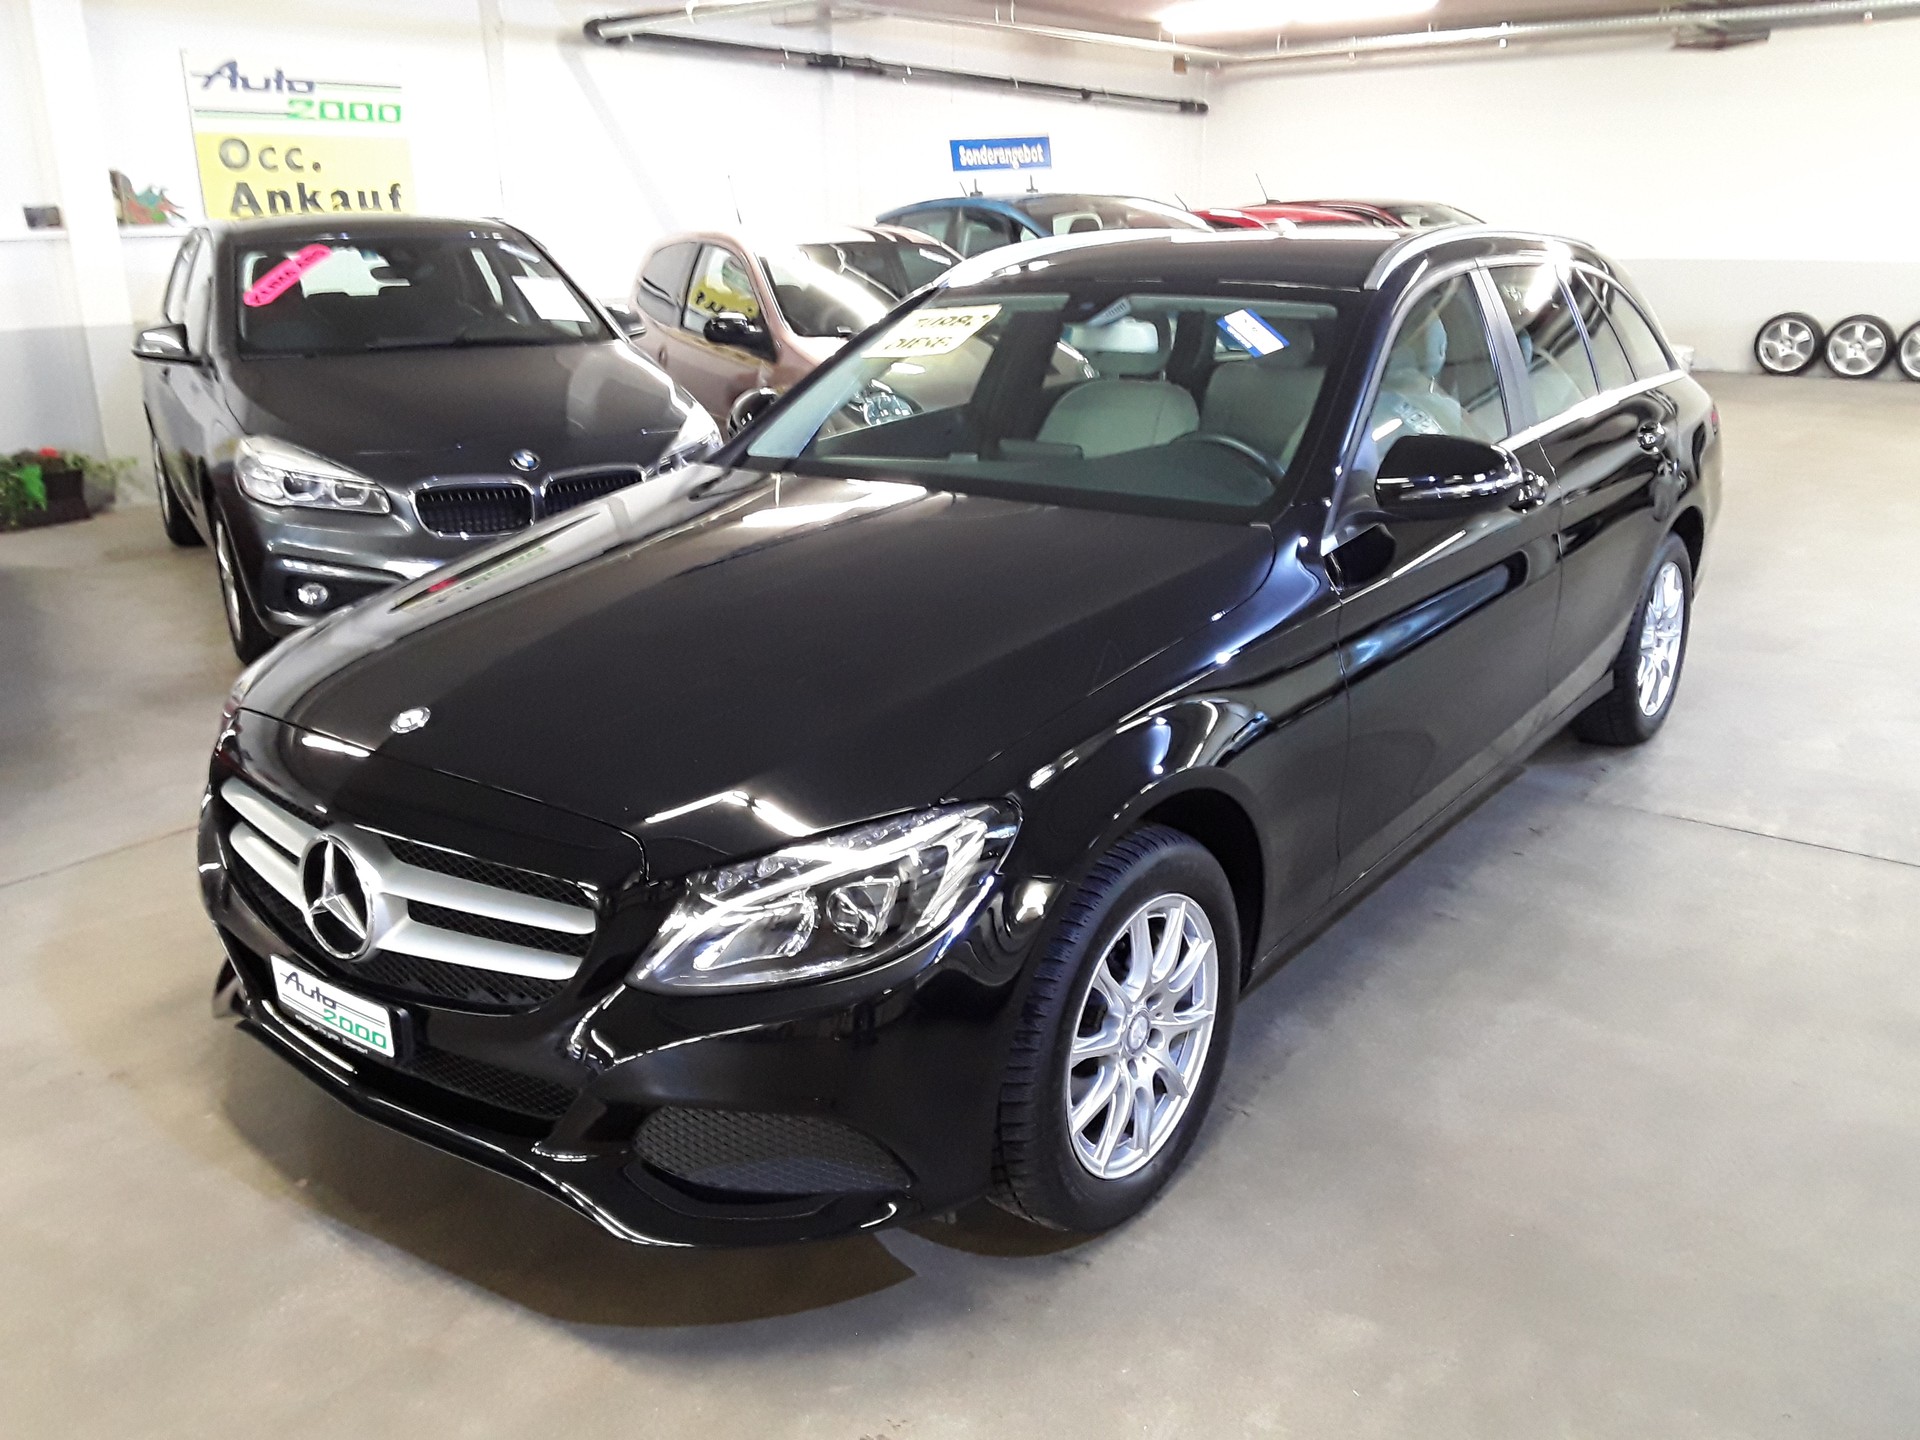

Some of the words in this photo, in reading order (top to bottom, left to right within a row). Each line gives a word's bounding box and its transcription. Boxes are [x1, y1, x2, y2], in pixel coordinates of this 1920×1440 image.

[200, 60, 316, 94] Auto
[287, 98, 402, 123] 2000
[218, 137, 322, 172] Occ.
[958, 143, 1045, 169] Sonderangebot
[229, 181, 402, 217] Ankauf
[283, 971, 337, 1010] Auto
[323, 1008, 387, 1050] 2000
